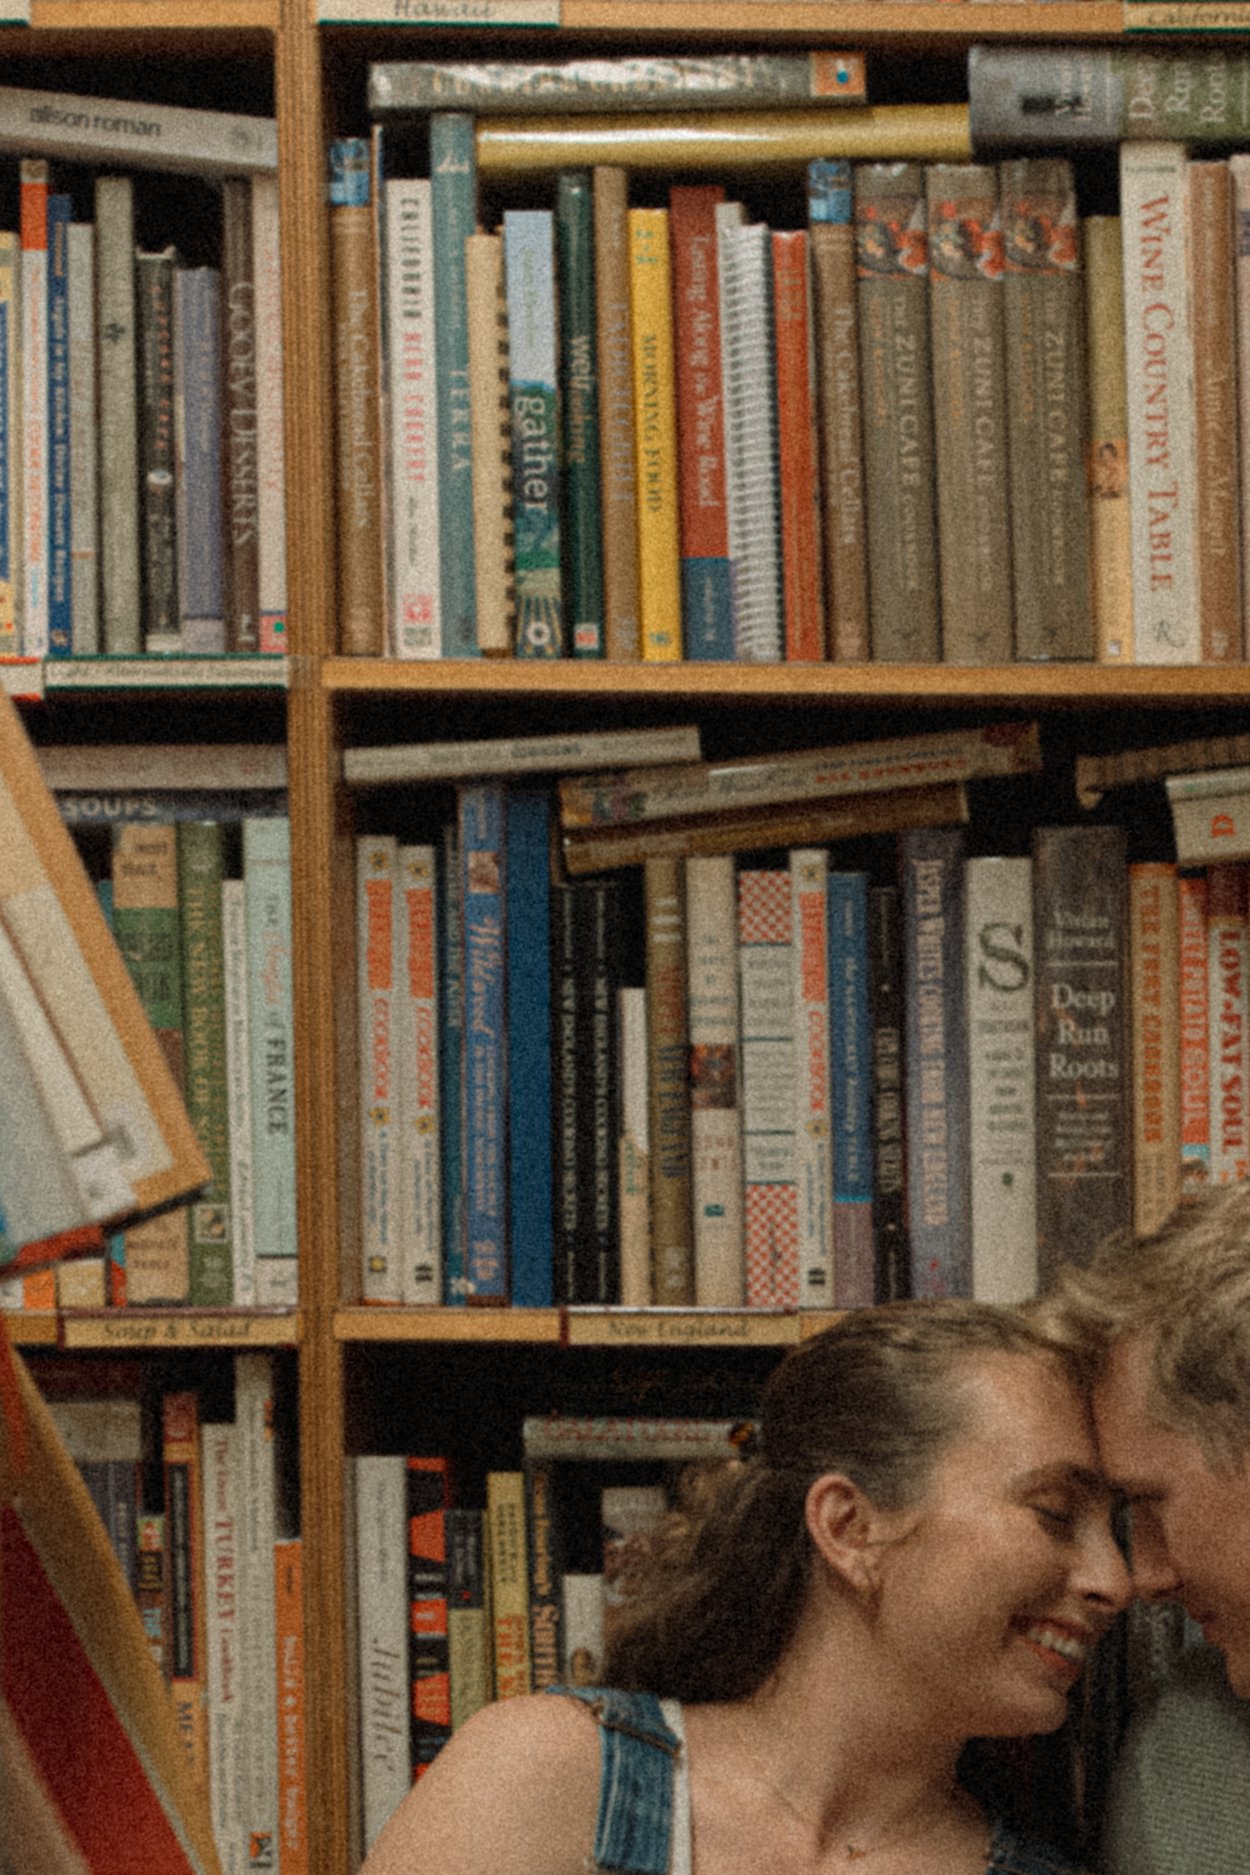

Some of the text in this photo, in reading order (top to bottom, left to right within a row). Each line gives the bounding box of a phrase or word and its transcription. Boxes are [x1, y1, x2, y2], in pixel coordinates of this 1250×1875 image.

[29, 104, 162, 138] alison roman
[399, 198, 423, 320] CALIFORNIA
[688, 235, 713, 301] Tasting
[691, 307, 715, 367] Along
[894, 334, 915, 407] ZUNI
[973, 336, 993, 409] ZUNI
[1044, 330, 1066, 402] ZUNI
[229, 281, 259, 546] GOOEY DESSERTS
[350, 333, 371, 448] Cakebread
[449, 366, 471, 473] TERRA
[640, 334, 664, 512] MORNING FOOD
[695, 398, 719, 450] Wine
[834, 352, 856, 463] Cakebread
[1138, 195, 1179, 593] WINE COUNTRY TABLE
[354, 453, 374, 528] Cellars
[515, 393, 550, 519] gather
[698, 455, 719, 508] Road
[838, 469, 858, 545] Cellars
[468, 914, 504, 1036] Wildwood
[1050, 983, 1116, 1016] Deep
[1184, 965, 1208, 1040] POTATO
[189, 1008, 207, 1068] BOOK
[918, 984, 946, 1048] COOKING
[1057, 1018, 1109, 1046] Run
[1141, 884, 1163, 1143] THE FORT COOKBOOK
[1218, 930, 1245, 1154] LOW-FAT SOUL
[265, 1037, 288, 1136] FRANCE
[920, 1059, 947, 1103] FROM
[1048, 1053, 1119, 1079] Roots
[1184, 1045, 1208, 1125] SOUL
[921, 1108, 948, 1144] NEW
[562, 1170, 576, 1230] SECRETS
[594, 1170, 609, 1230] SECRETS
[922, 1150, 949, 1226] ENGLAND
[102, 1322, 158, 1341] Soup
[190, 1321, 251, 1338] Salad
[657, 1319, 748, 1339] England
[213, 1438, 230, 1466] The
[212, 1516, 238, 1624] TURKEY
[497, 1615, 514, 1663] THE
[370, 1636, 402, 1772] Jubilee
[284, 1713, 301, 1780] better
